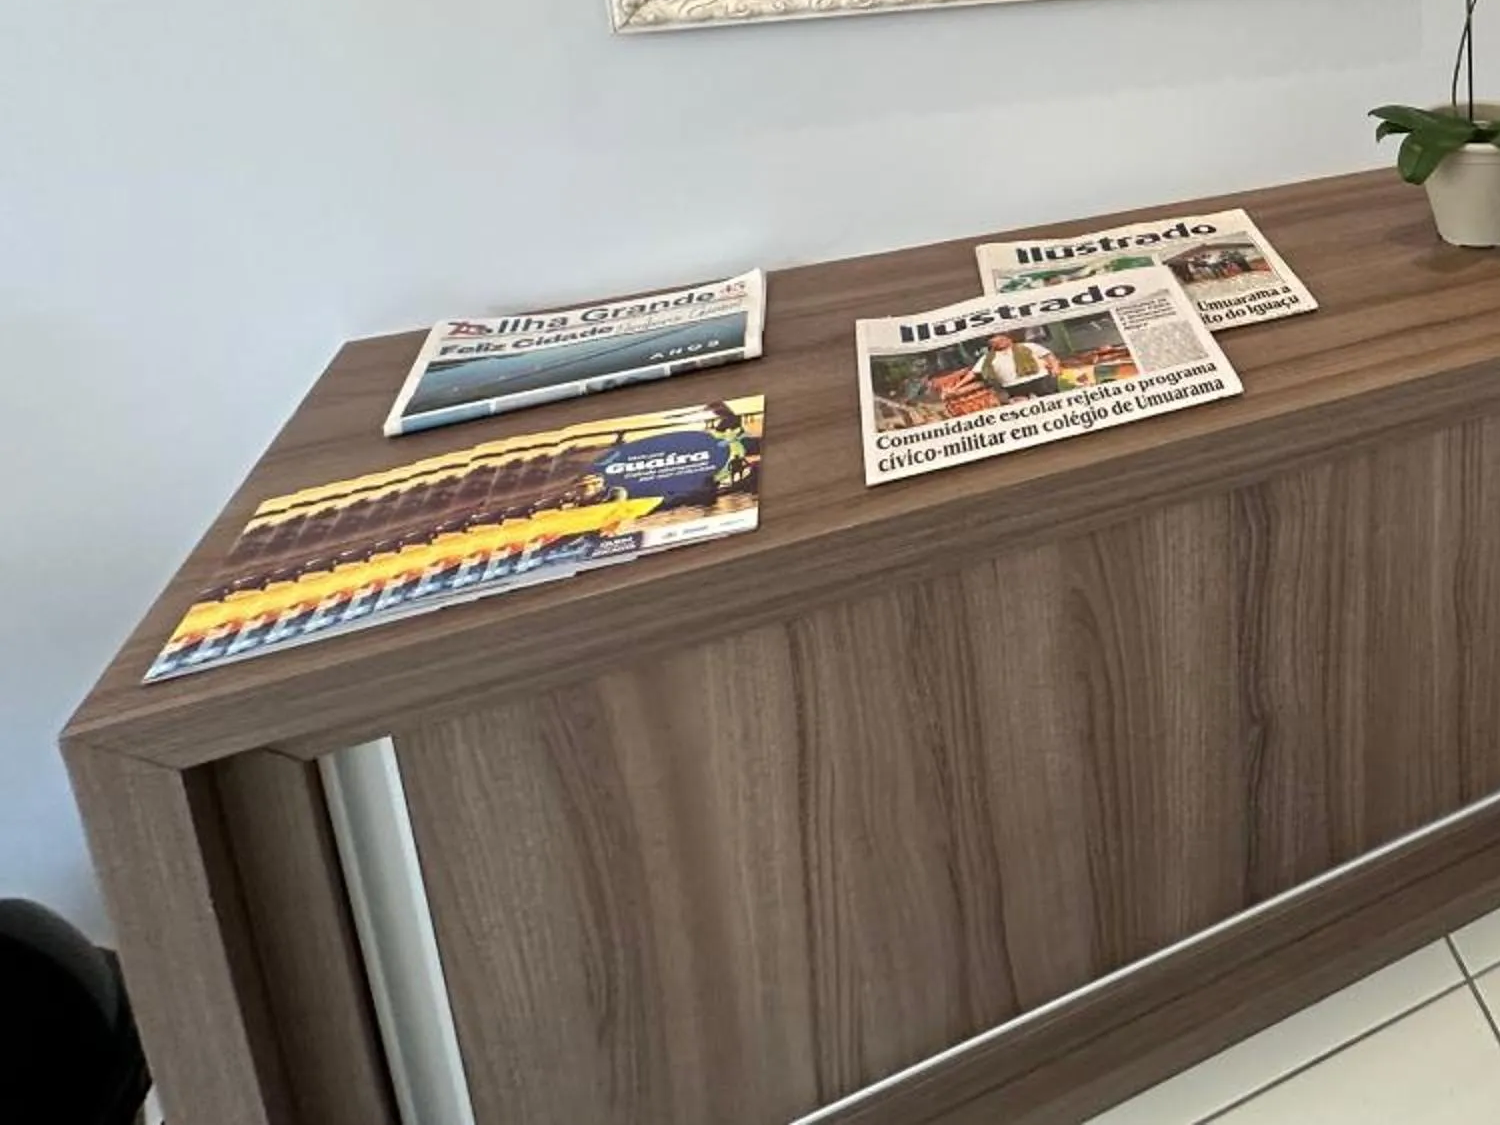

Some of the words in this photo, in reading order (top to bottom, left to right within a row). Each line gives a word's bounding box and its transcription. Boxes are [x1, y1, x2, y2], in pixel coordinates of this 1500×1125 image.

[1016, 223, 1217, 264] Ilustrado
[581, 292, 715, 321] Grande
[900, 284, 1136, 343] Ilustrado
[1197, 288, 1279, 312] Umuarama
[1282, 285, 1291, 295] a
[1225, 309, 1246, 320] do
[1247, 295, 1299, 316] Iguaçu
[876, 413, 996, 450] Comunidade
[999, 399, 1064, 423] escolar
[1067, 384, 1122, 407] rejeita
[1124, 382, 1135, 392] o
[1138, 362, 1217, 392] programa
[878, 431, 1007, 472] cívico-militar
[1011, 424, 1038, 440] em
[1042, 406, 1108, 433] colégio
[1112, 400, 1133, 416] de
[1134, 378, 1225, 409] Umuarama
